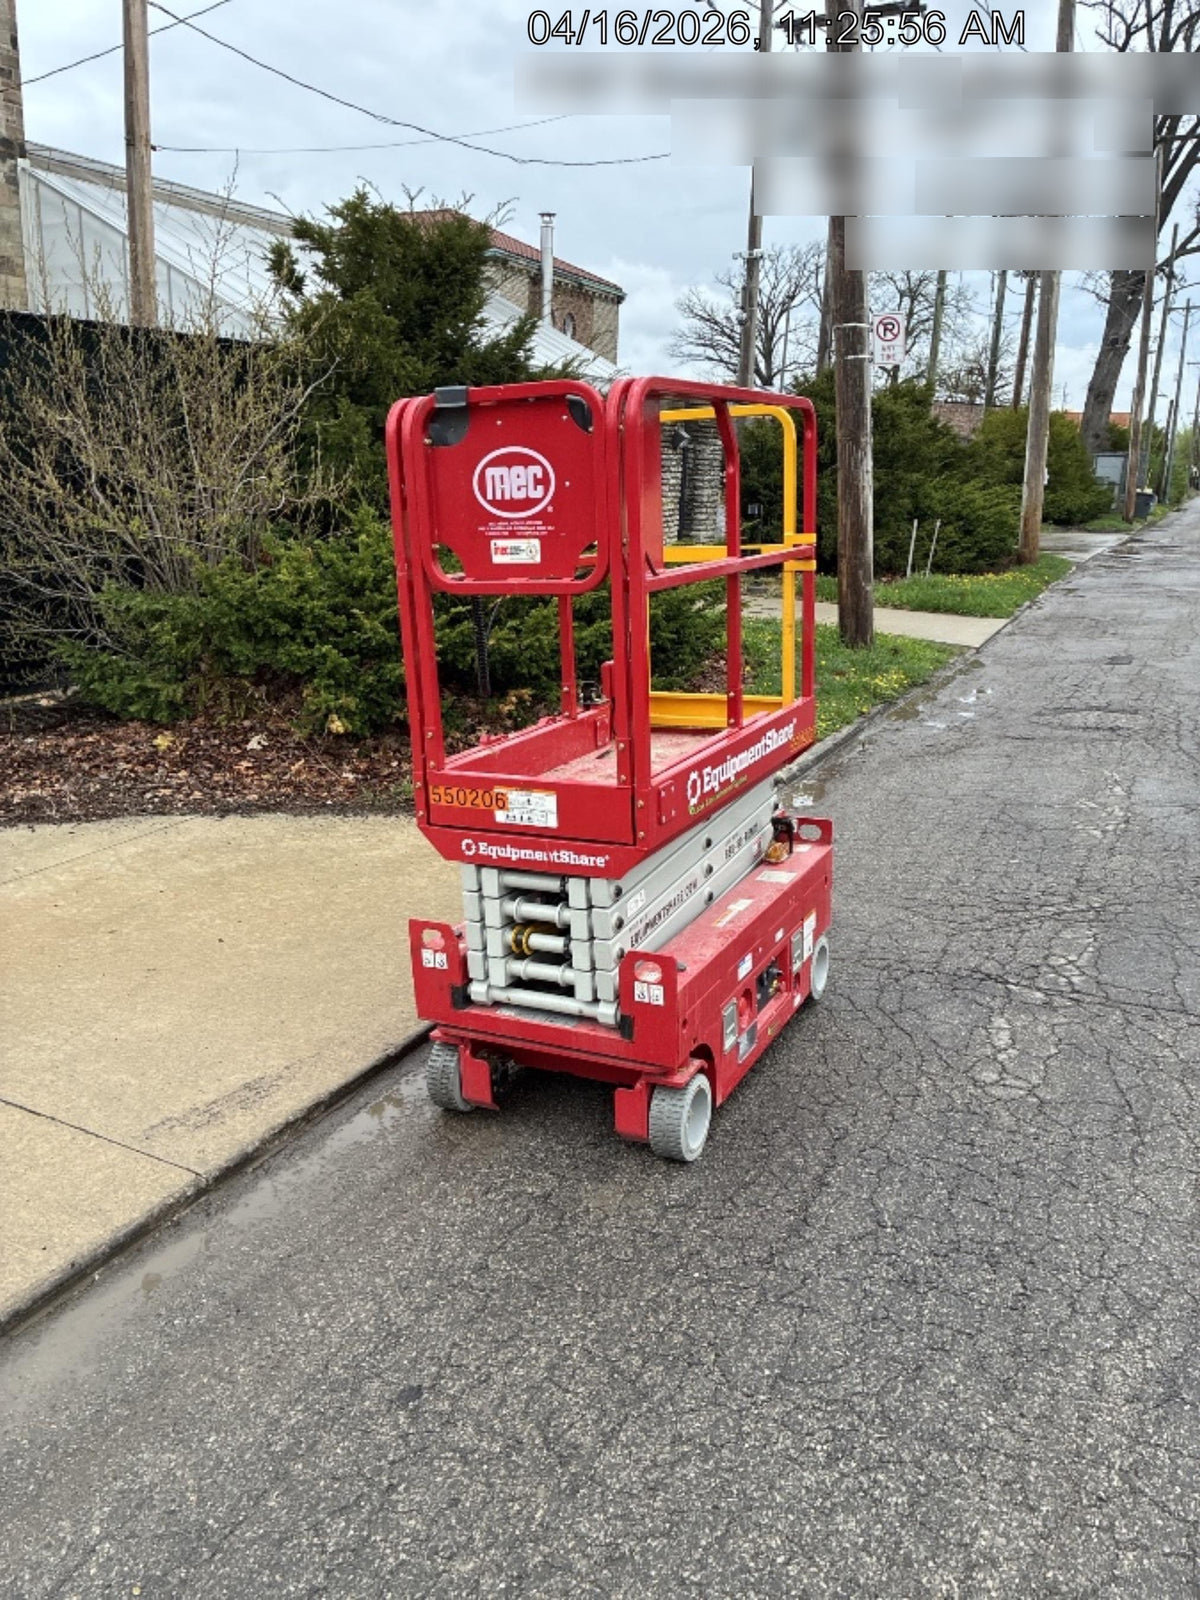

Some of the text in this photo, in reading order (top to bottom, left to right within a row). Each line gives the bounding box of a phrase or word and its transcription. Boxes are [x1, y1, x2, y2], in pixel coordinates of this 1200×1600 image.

[703, 722, 795, 793] EquipmentShare
[431, 785, 507, 811] 550206
[477, 841, 606, 868] EquipmentShare
